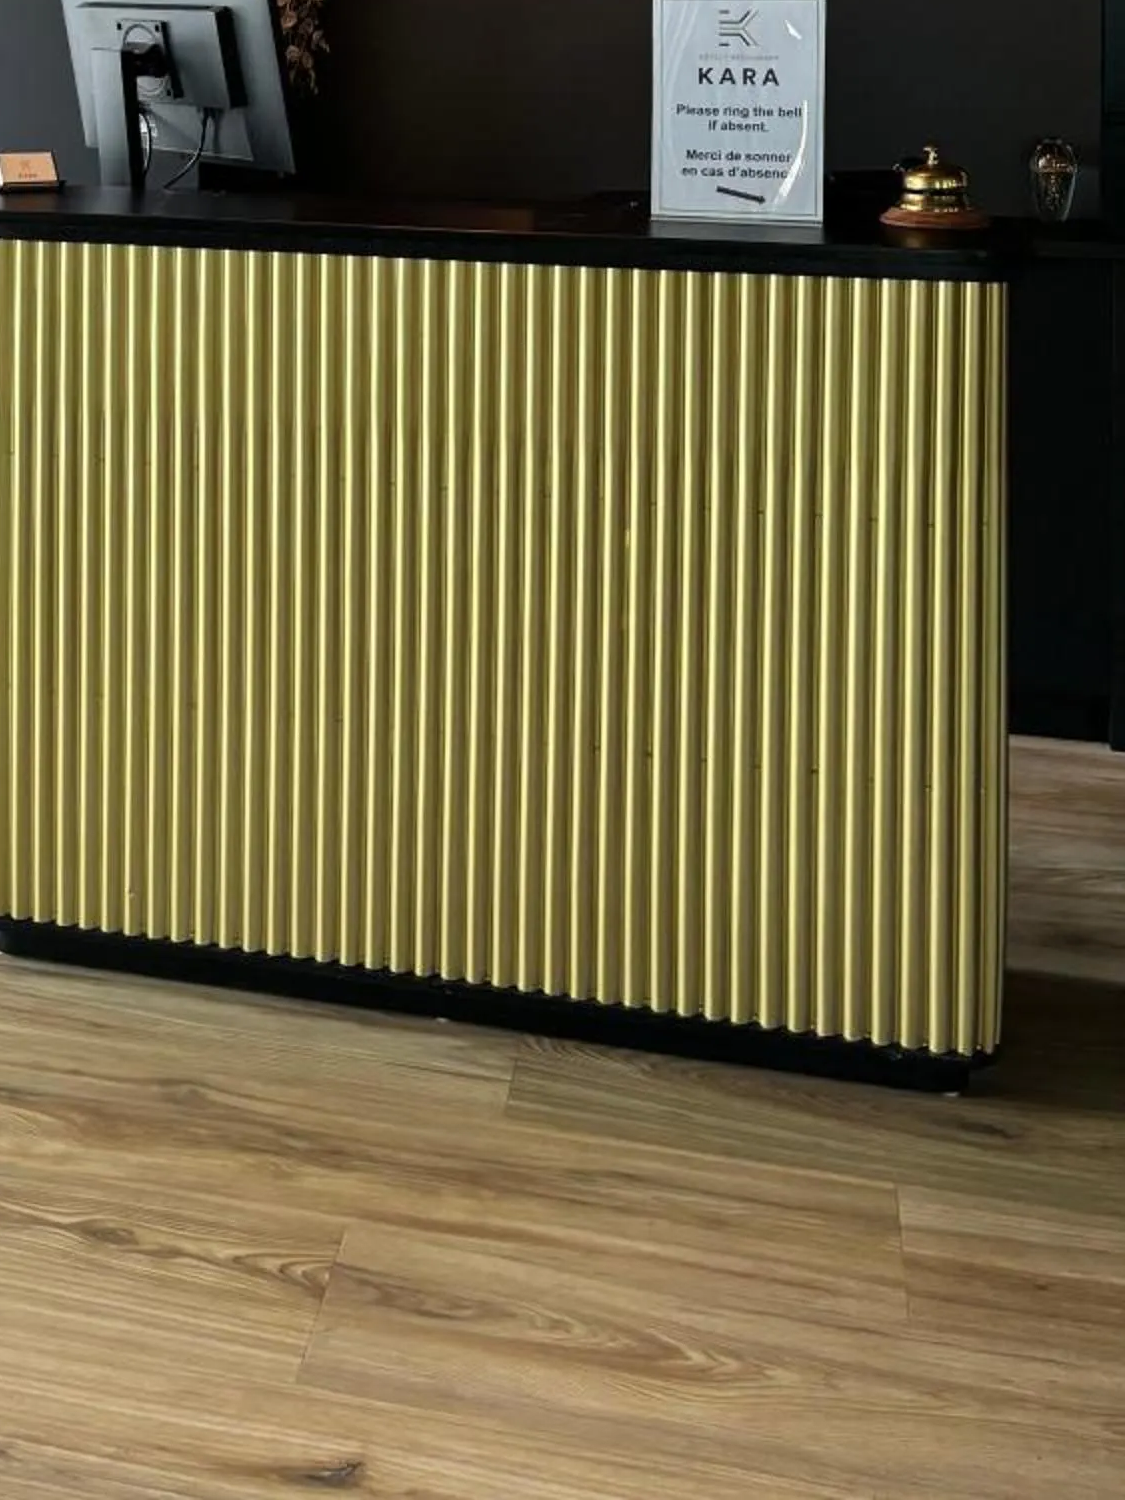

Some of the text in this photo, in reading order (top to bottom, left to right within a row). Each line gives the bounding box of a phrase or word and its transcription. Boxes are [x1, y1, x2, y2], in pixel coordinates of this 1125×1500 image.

[698, 67, 780, 86] KARA
[676, 103, 802, 118] Please ring the bell
[686, 149, 792, 163] Merci de sonner
[682, 166, 795, 179] en cas d'absenc
